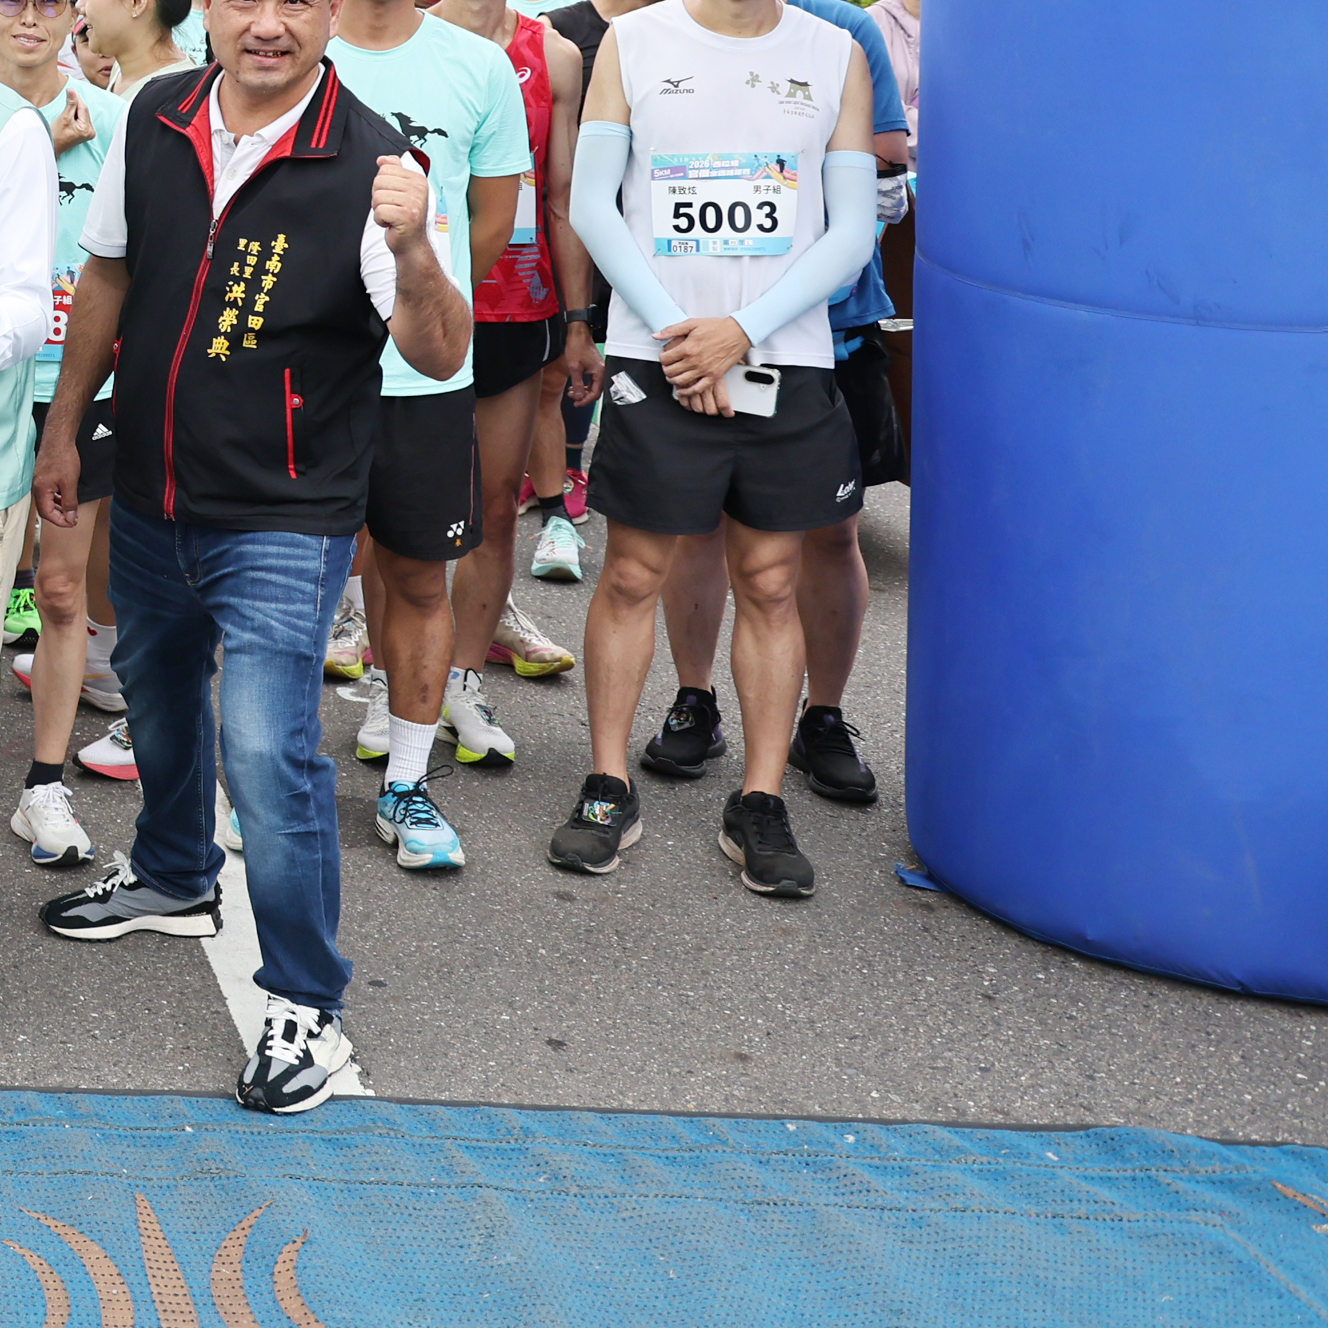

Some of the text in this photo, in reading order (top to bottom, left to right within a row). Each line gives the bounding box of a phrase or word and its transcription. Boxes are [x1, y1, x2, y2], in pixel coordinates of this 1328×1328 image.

[752, 185, 782, 195] 男子組
[672, 200, 779, 234] 5003
[672, 245, 694, 253] 0187
[242, 233, 289, 349] 臺南市官田區
